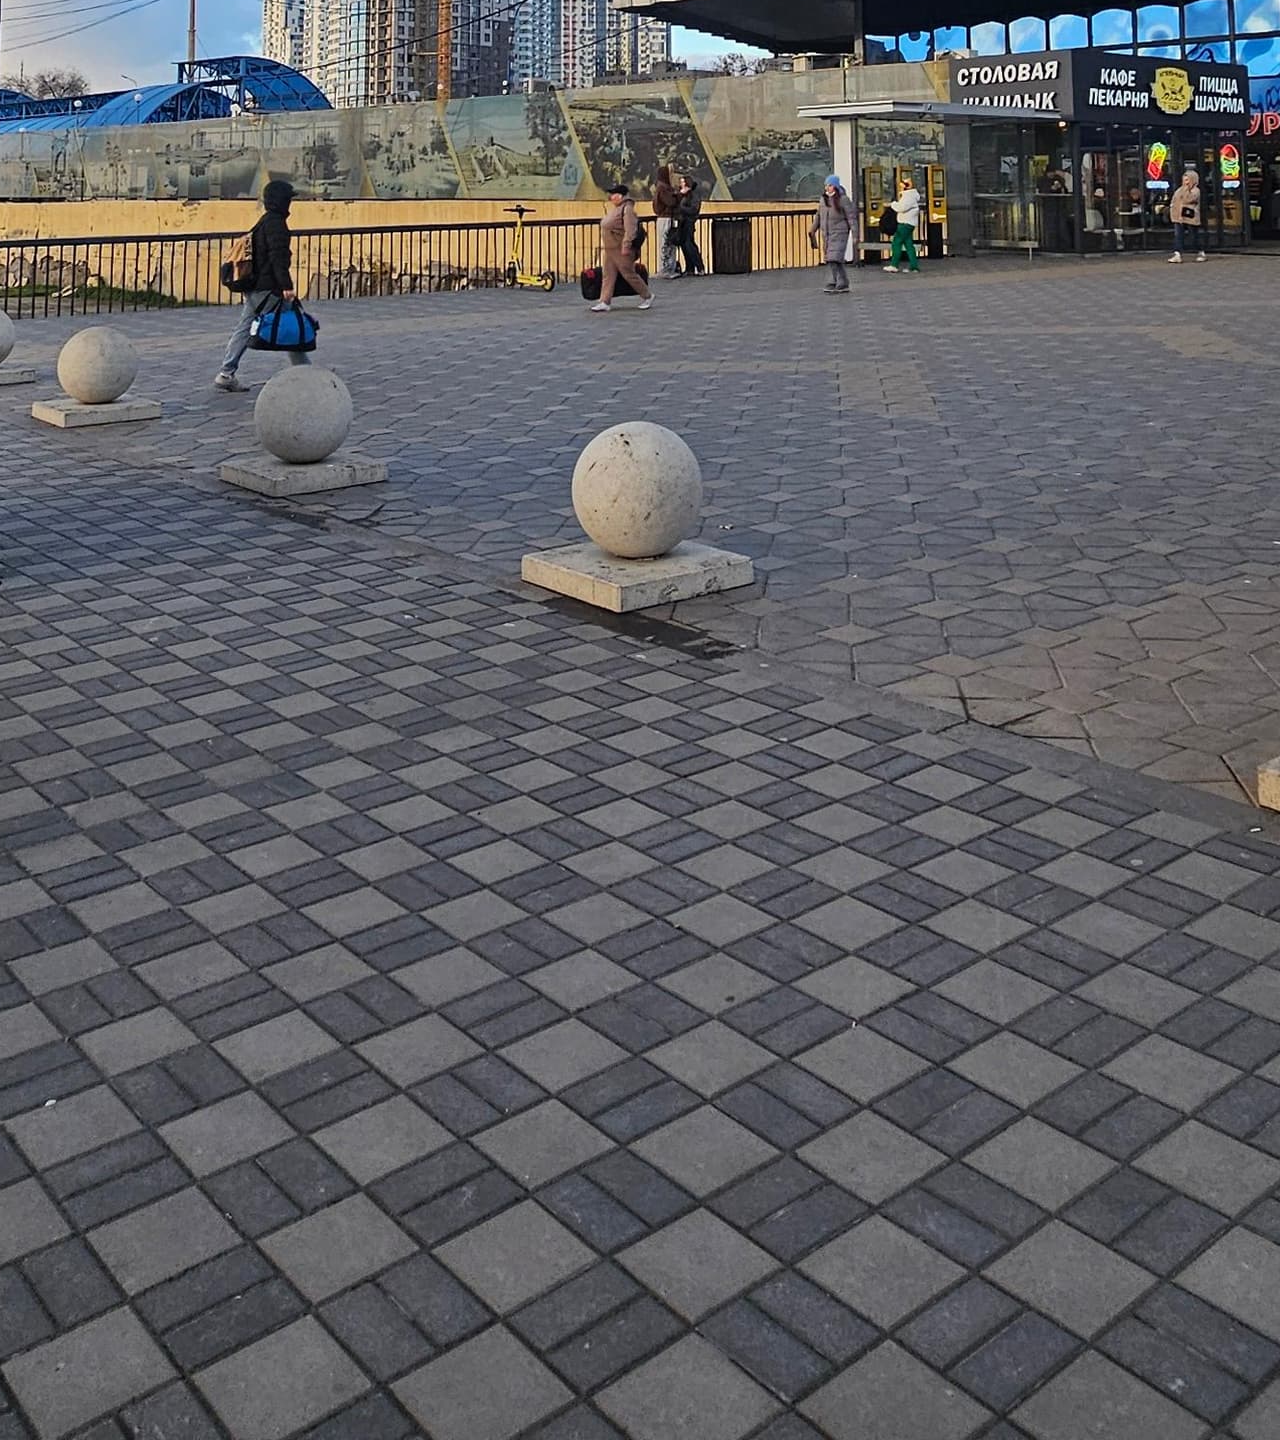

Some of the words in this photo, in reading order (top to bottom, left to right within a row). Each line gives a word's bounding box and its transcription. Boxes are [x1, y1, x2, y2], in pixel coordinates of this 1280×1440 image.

[957, 60, 1058, 86] СТОЛОВАЯ
[1100, 68, 1136, 88] КАФЕ
[1199, 76, 1238, 94] ПИЦЦА
[1088, 87, 1149, 109] ПЕКАРНЯ
[1194, 94, 1245, 114] ШАУРМА
